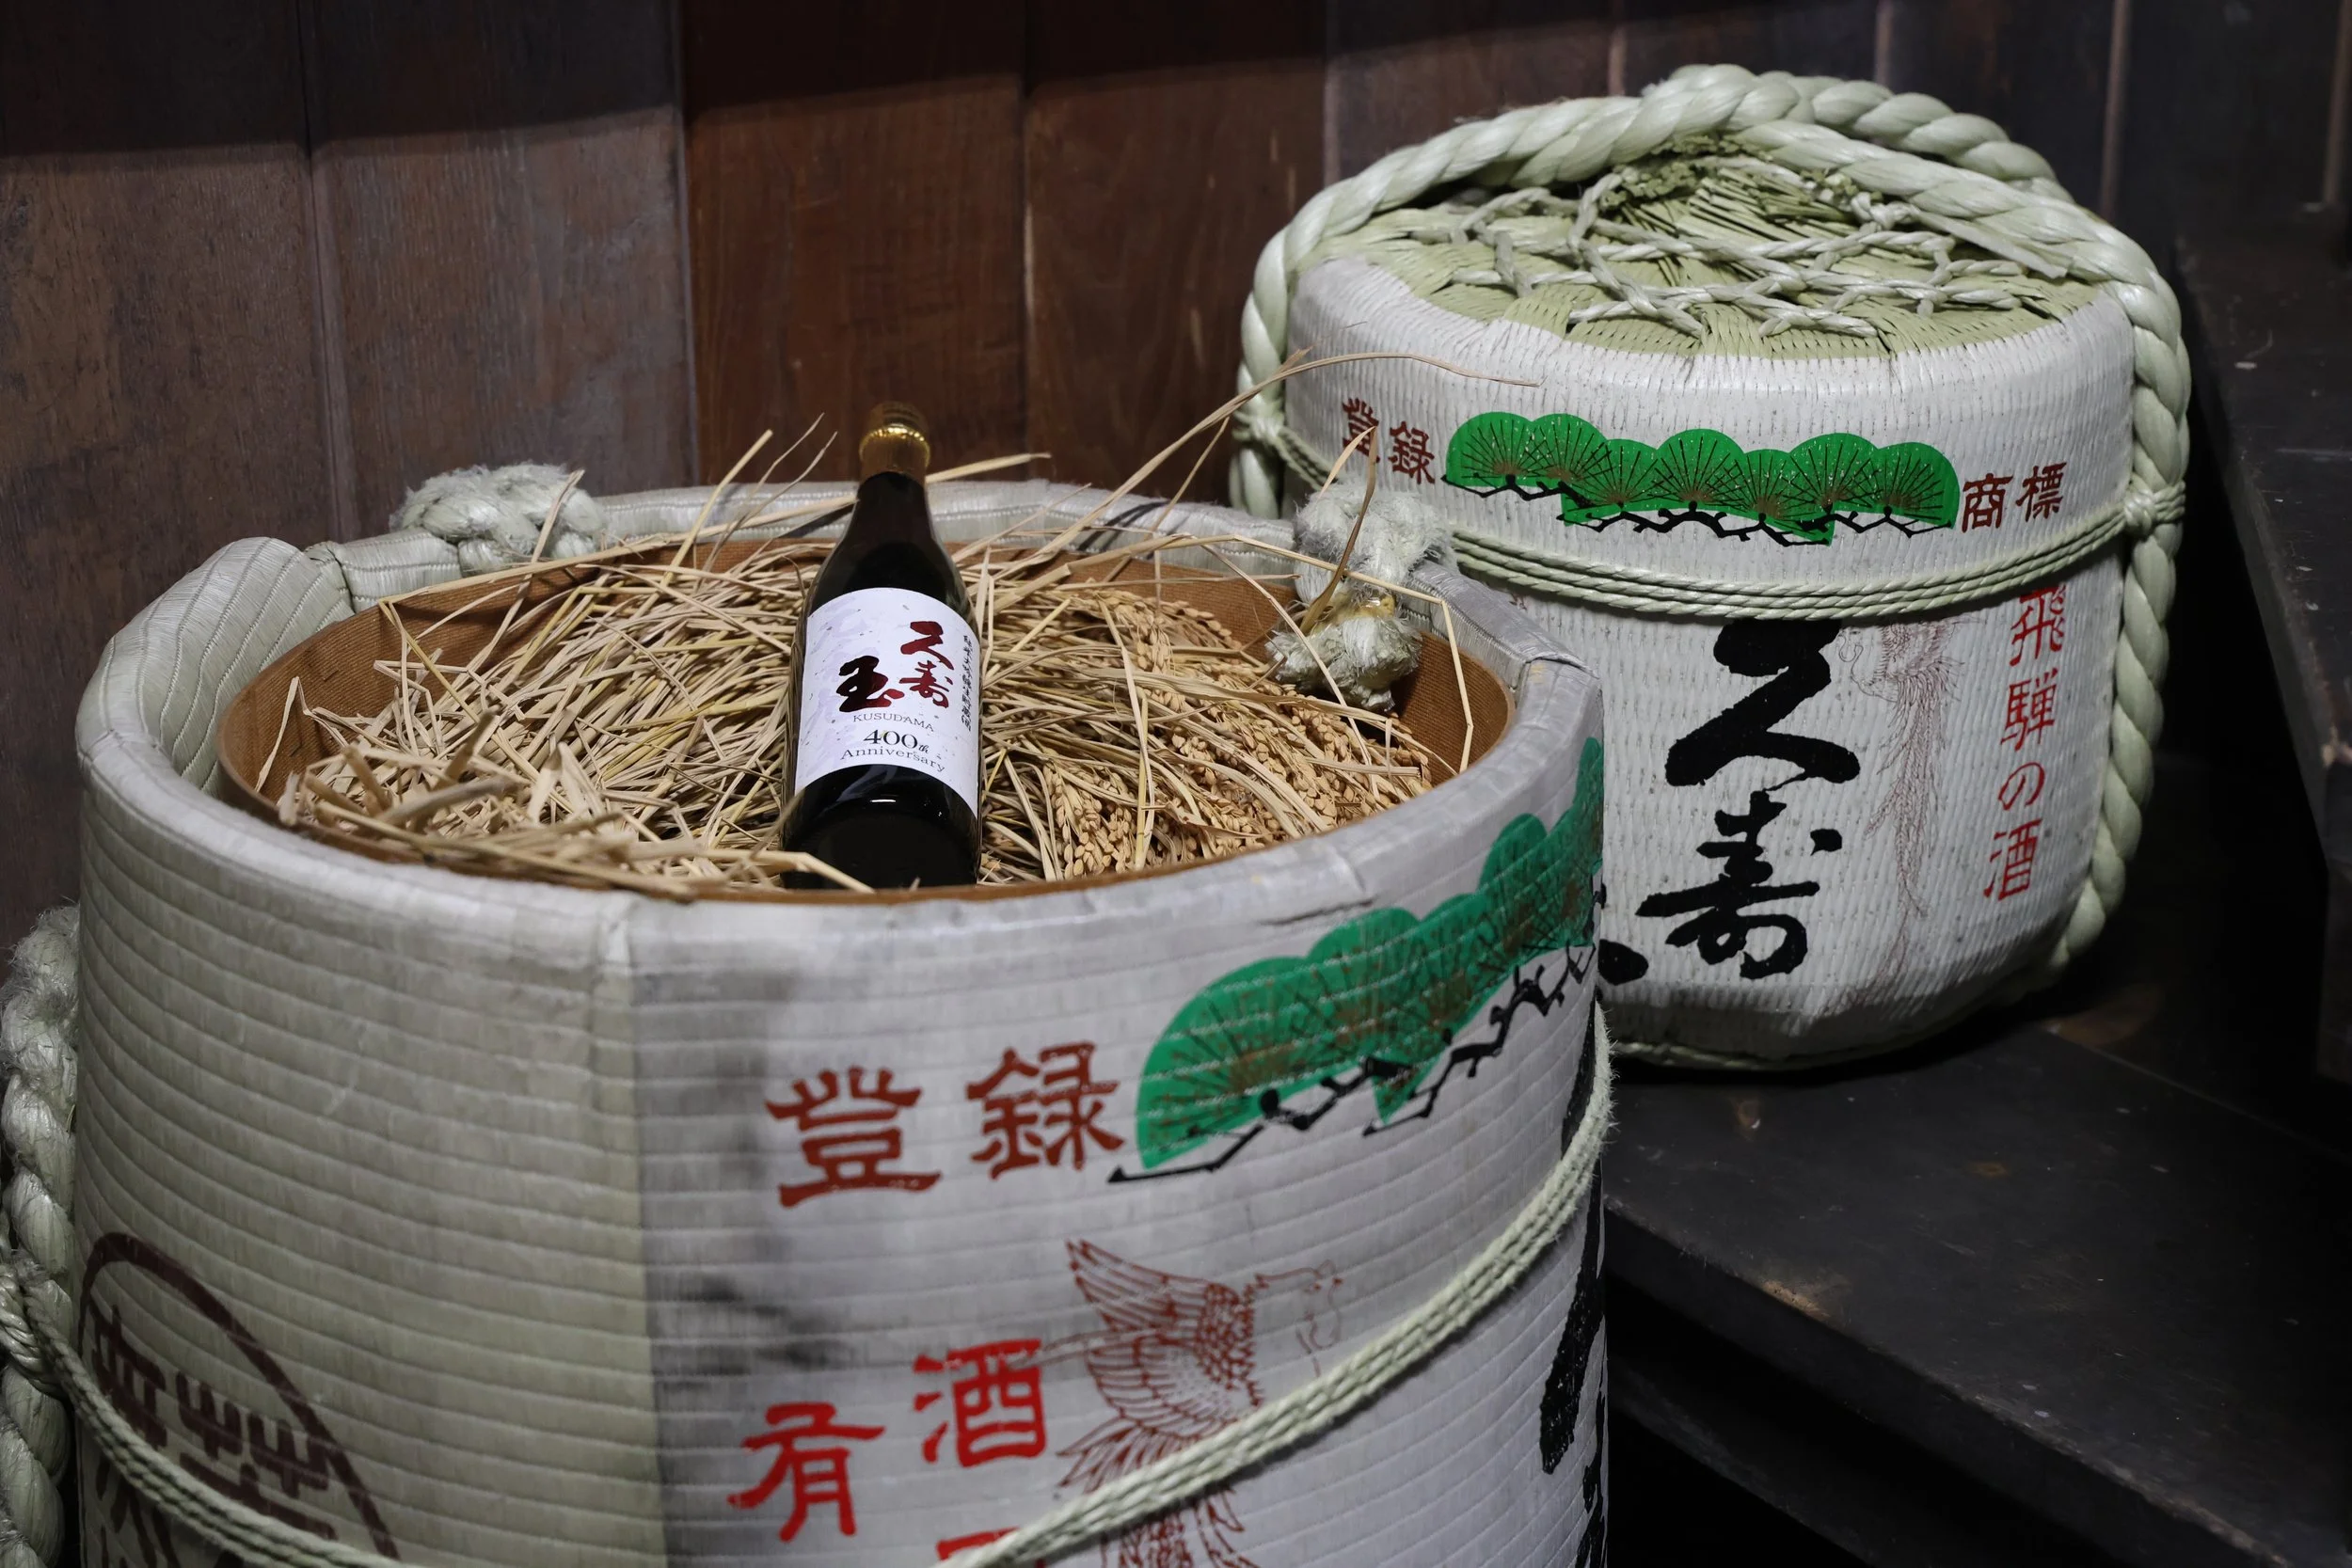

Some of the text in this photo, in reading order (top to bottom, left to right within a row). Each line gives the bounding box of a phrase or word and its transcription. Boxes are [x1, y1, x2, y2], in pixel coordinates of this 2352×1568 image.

[1343, 397, 2067, 533] 登録 商標
[840, 746, 946, 772] Anniversary
[852, 712, 934, 732] KUSUDAMA
[863, 729, 930, 753] 400th
[1982, 584, 2067, 901] 飛騨の酒
[764, 1041, 1125, 1209] 登録
